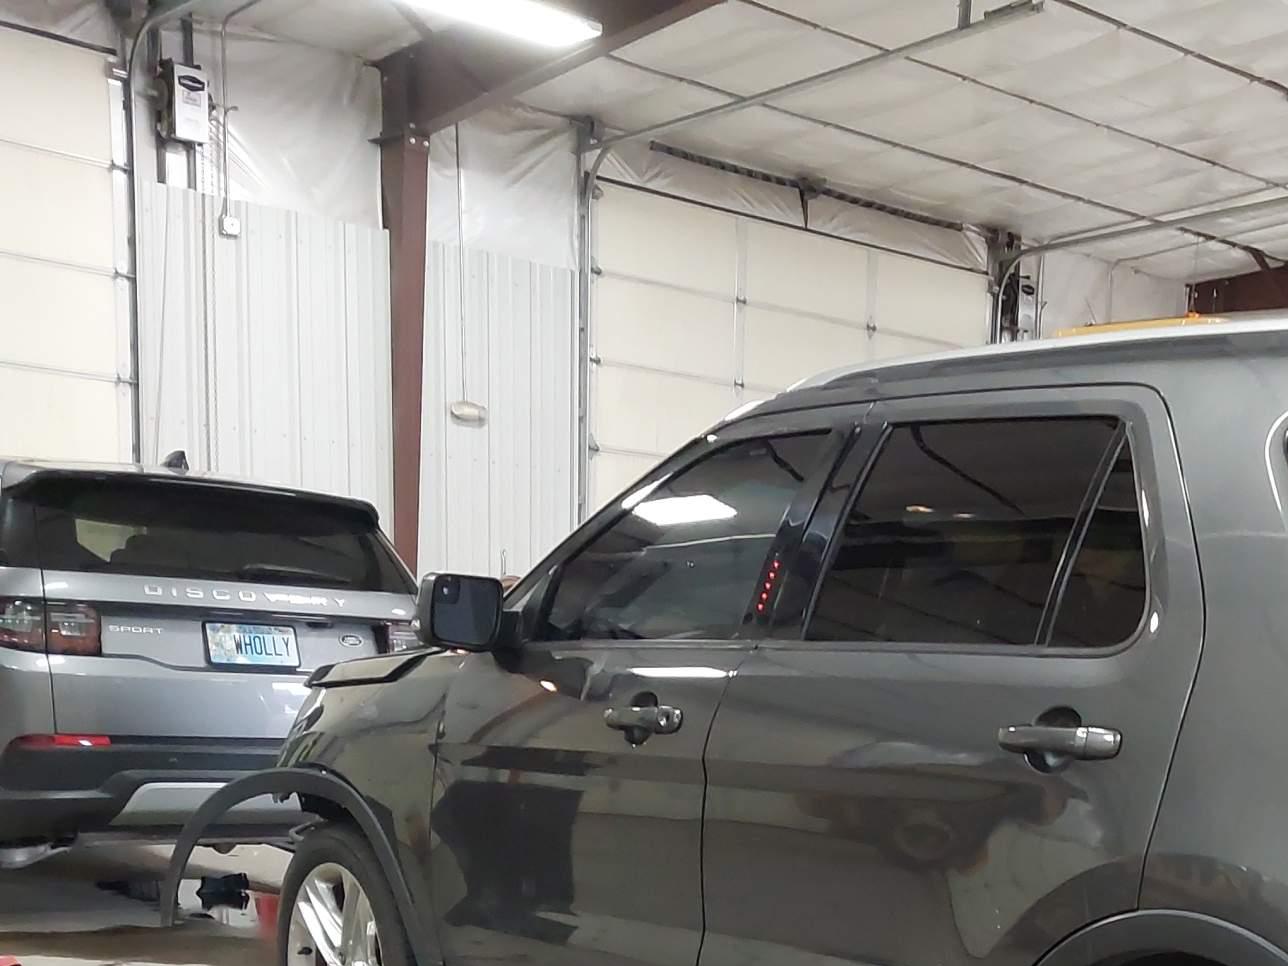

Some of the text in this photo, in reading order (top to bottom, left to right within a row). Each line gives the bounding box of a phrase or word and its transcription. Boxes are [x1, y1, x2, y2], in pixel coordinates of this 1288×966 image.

[144, 584, 345, 608] DISCOVRY
[108, 624, 163, 635] SPORT
[233, 634, 290, 657] WHOLLY
